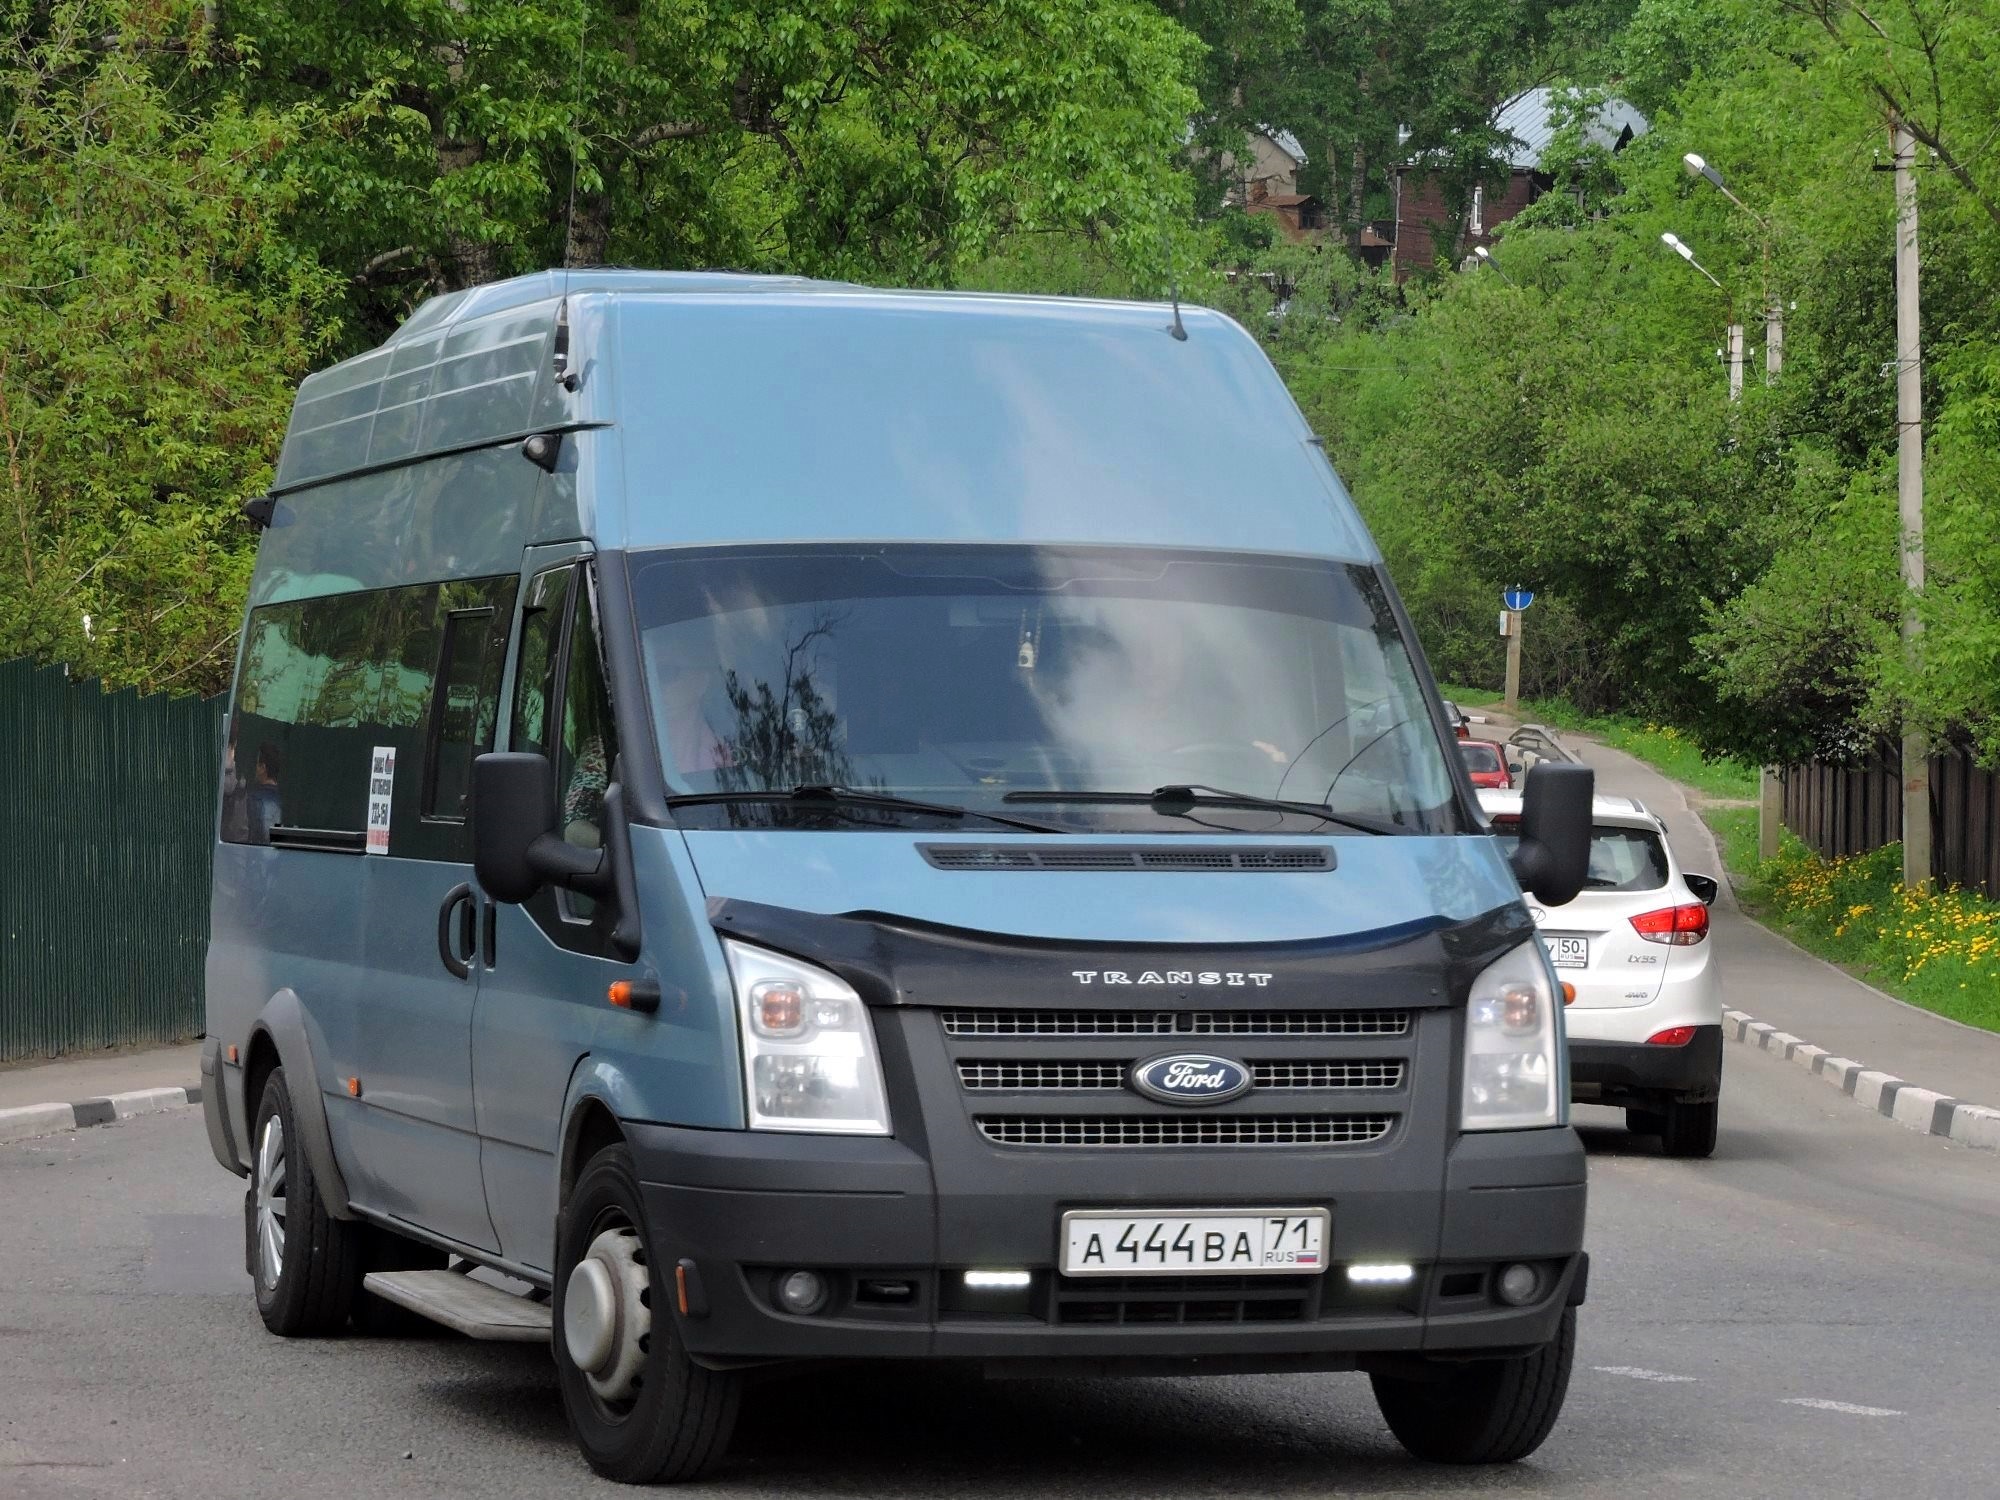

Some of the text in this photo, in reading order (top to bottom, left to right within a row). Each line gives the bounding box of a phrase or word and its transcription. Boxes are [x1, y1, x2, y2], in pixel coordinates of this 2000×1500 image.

[1561, 940, 1580, 953] 50
[1072, 971, 1273, 986] TRANSIT
[1163, 1062, 1225, 1089] Ford
[1269, 1218, 1309, 1250] 71
[1265, 1251, 1295, 1263] RUS
